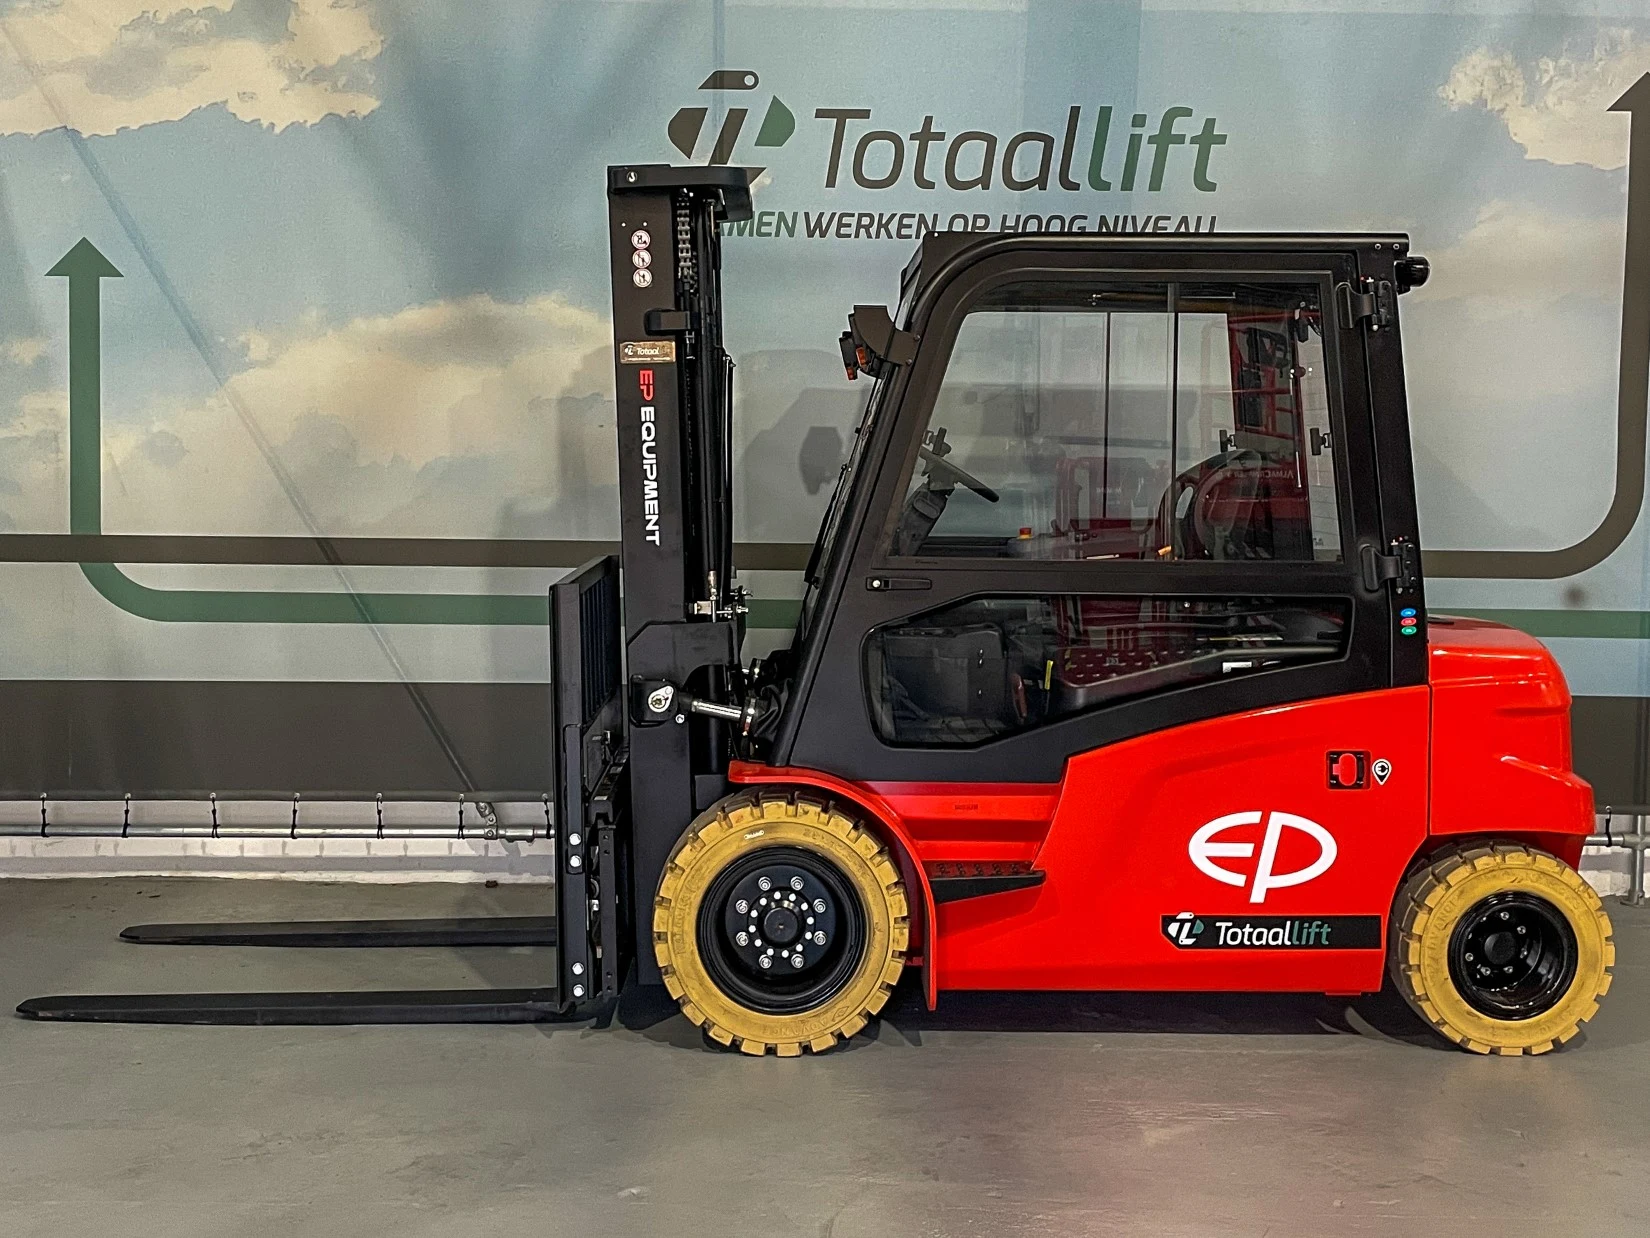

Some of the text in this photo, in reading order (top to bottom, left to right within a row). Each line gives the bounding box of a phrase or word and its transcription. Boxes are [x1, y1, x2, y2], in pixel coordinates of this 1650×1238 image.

[814, 105, 1227, 192] Totaallift
[720, 211, 798, 238] MEN
[804, 212, 939, 240] WERKEN
[1000, 214, 1088, 232] HOOG
[640, 370, 660, 546] EP EQUIPMENT
[1188, 811, 1338, 903] EP
[1215, 920, 1331, 945] Totaallift
